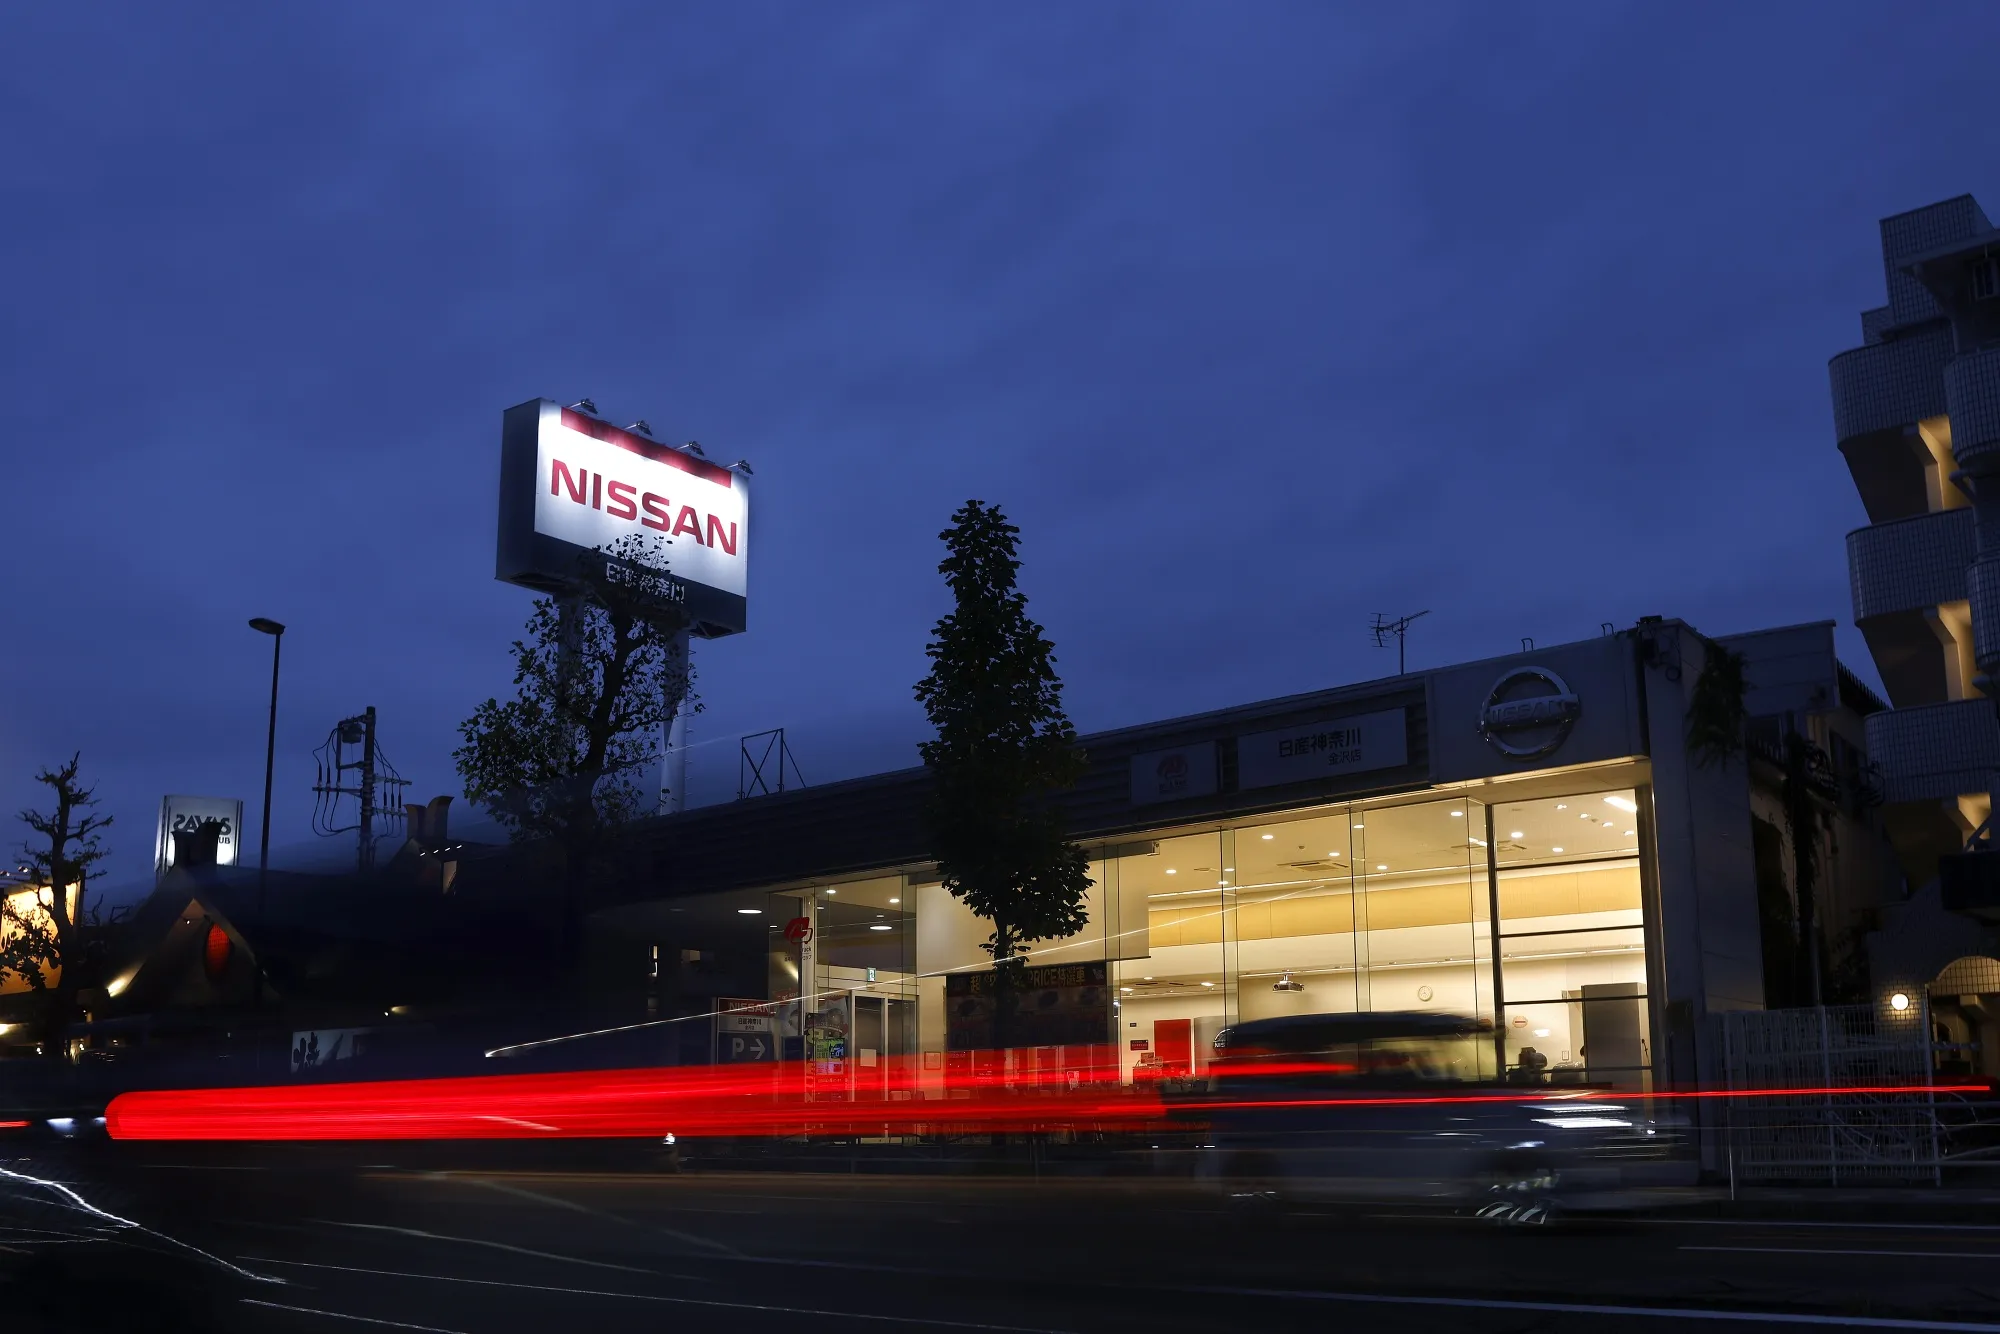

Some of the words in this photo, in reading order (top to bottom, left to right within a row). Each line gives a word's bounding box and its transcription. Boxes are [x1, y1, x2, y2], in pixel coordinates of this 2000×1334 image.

[551, 459, 737, 556] NISSAN
[1279, 727, 1361, 757] 日産神奈川
[1329, 749, 1361, 766] 金沢店
[728, 1002, 770, 1012] NISSAN
[732, 1038, 744, 1059] P
